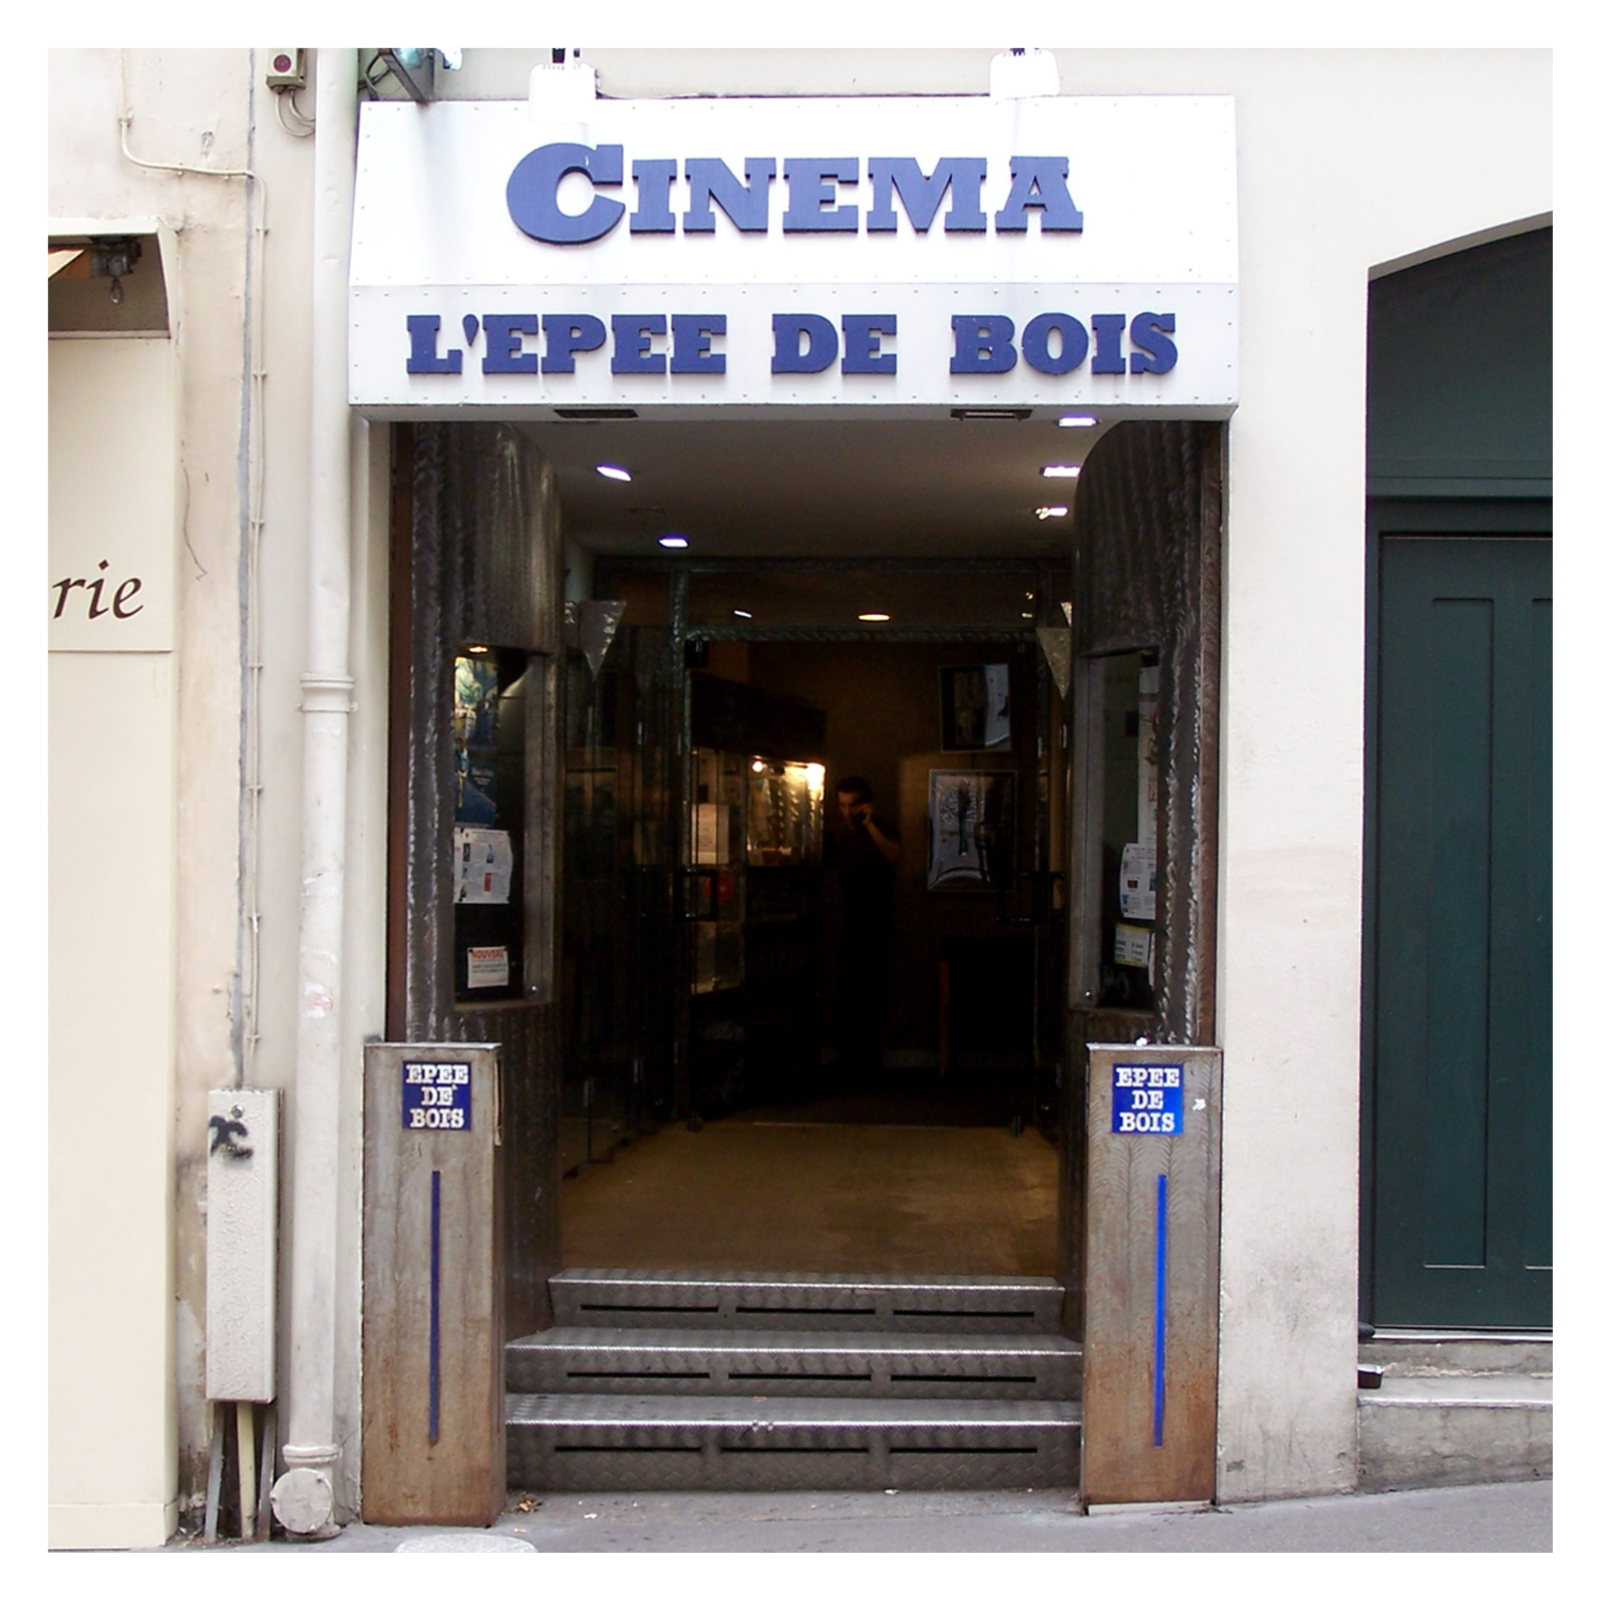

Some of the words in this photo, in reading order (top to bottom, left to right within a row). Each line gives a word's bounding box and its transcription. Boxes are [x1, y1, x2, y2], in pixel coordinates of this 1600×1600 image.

[507, 143, 1083, 243] CINEMA
[407, 313, 727, 373] L'EPEE
[772, 313, 898, 373] DE
[950, 312, 1178, 374] BOIS
[52, 559, 143, 619] rie
[405, 1064, 469, 1084] EPEE
[1115, 1067, 1180, 1088] EPEE
[421, 1086, 454, 1106] DE
[1131, 1090, 1164, 1110] DE
[410, 1108, 465, 1128] BOIS
[1119, 1112, 1176, 1132] BOIS
